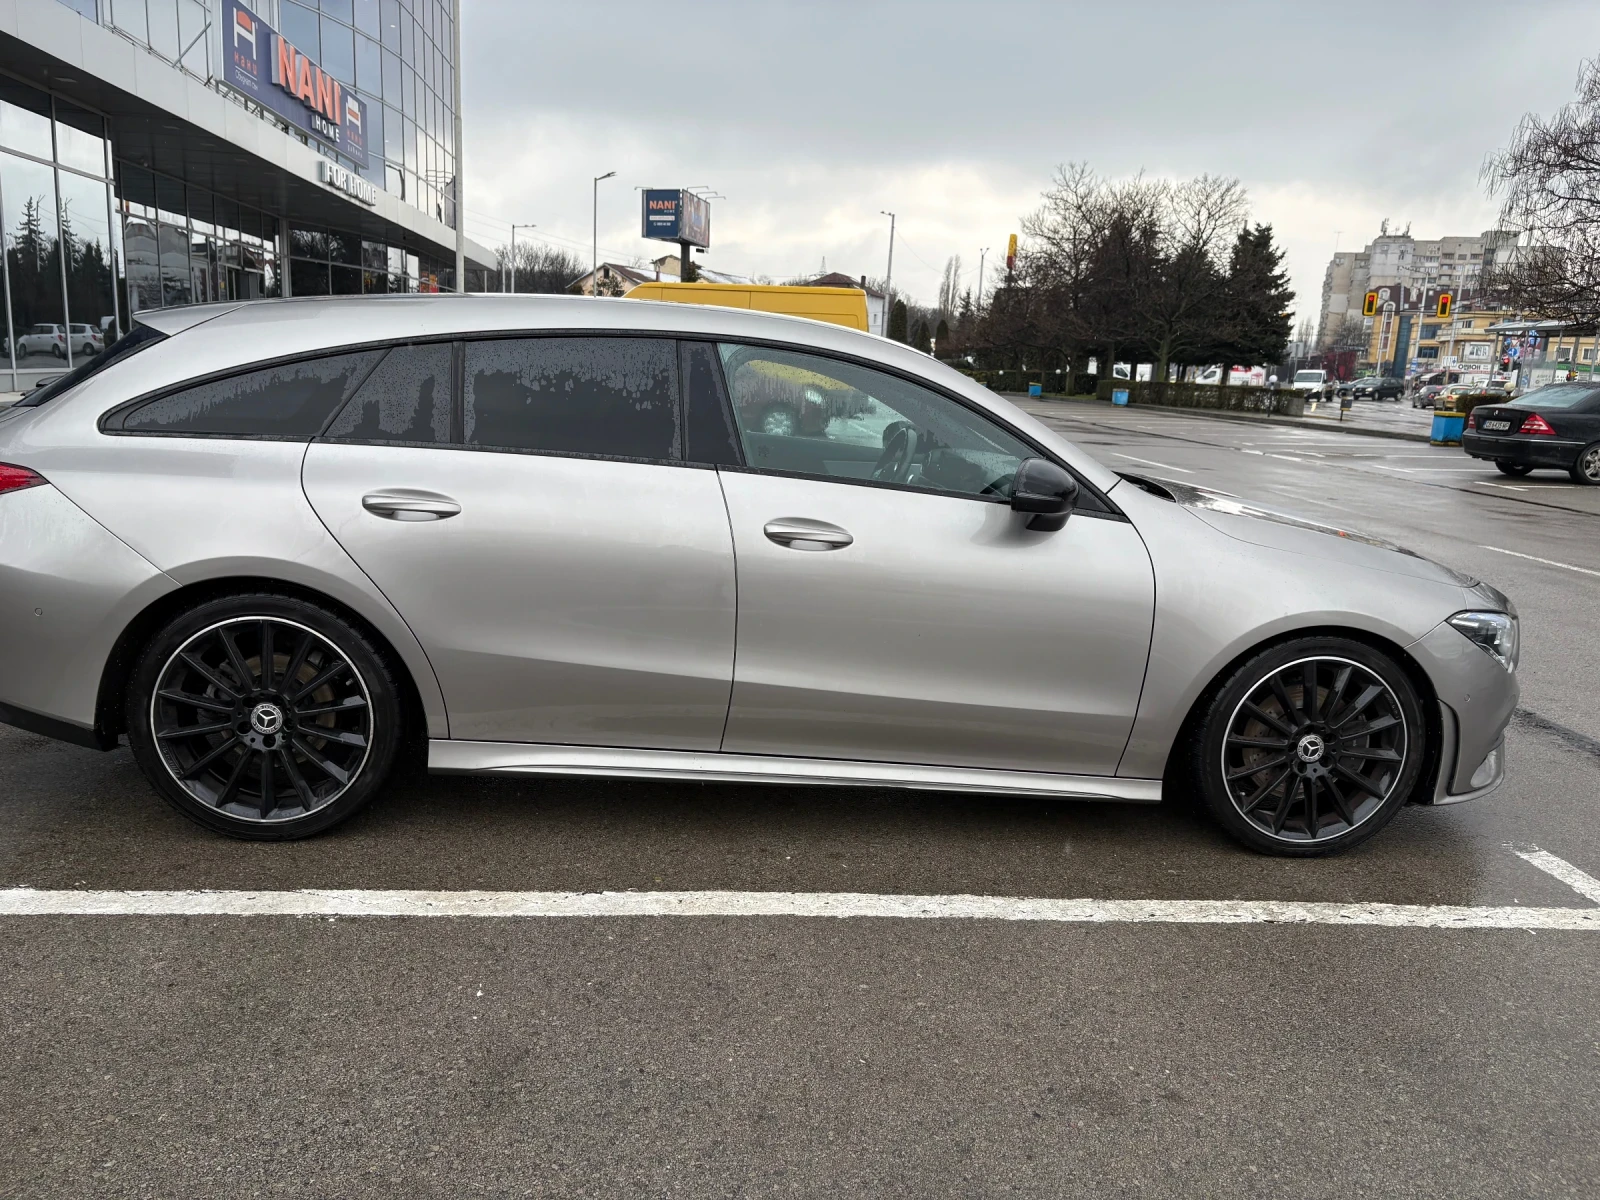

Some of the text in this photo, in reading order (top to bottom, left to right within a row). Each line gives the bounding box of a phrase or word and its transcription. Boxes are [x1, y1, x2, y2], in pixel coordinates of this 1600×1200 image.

[278, 35, 341, 126] NANI
[315, 114, 340, 143] HOME
[327, 163, 376, 204] FOR HOME
[649, 200, 675, 209] NANI
